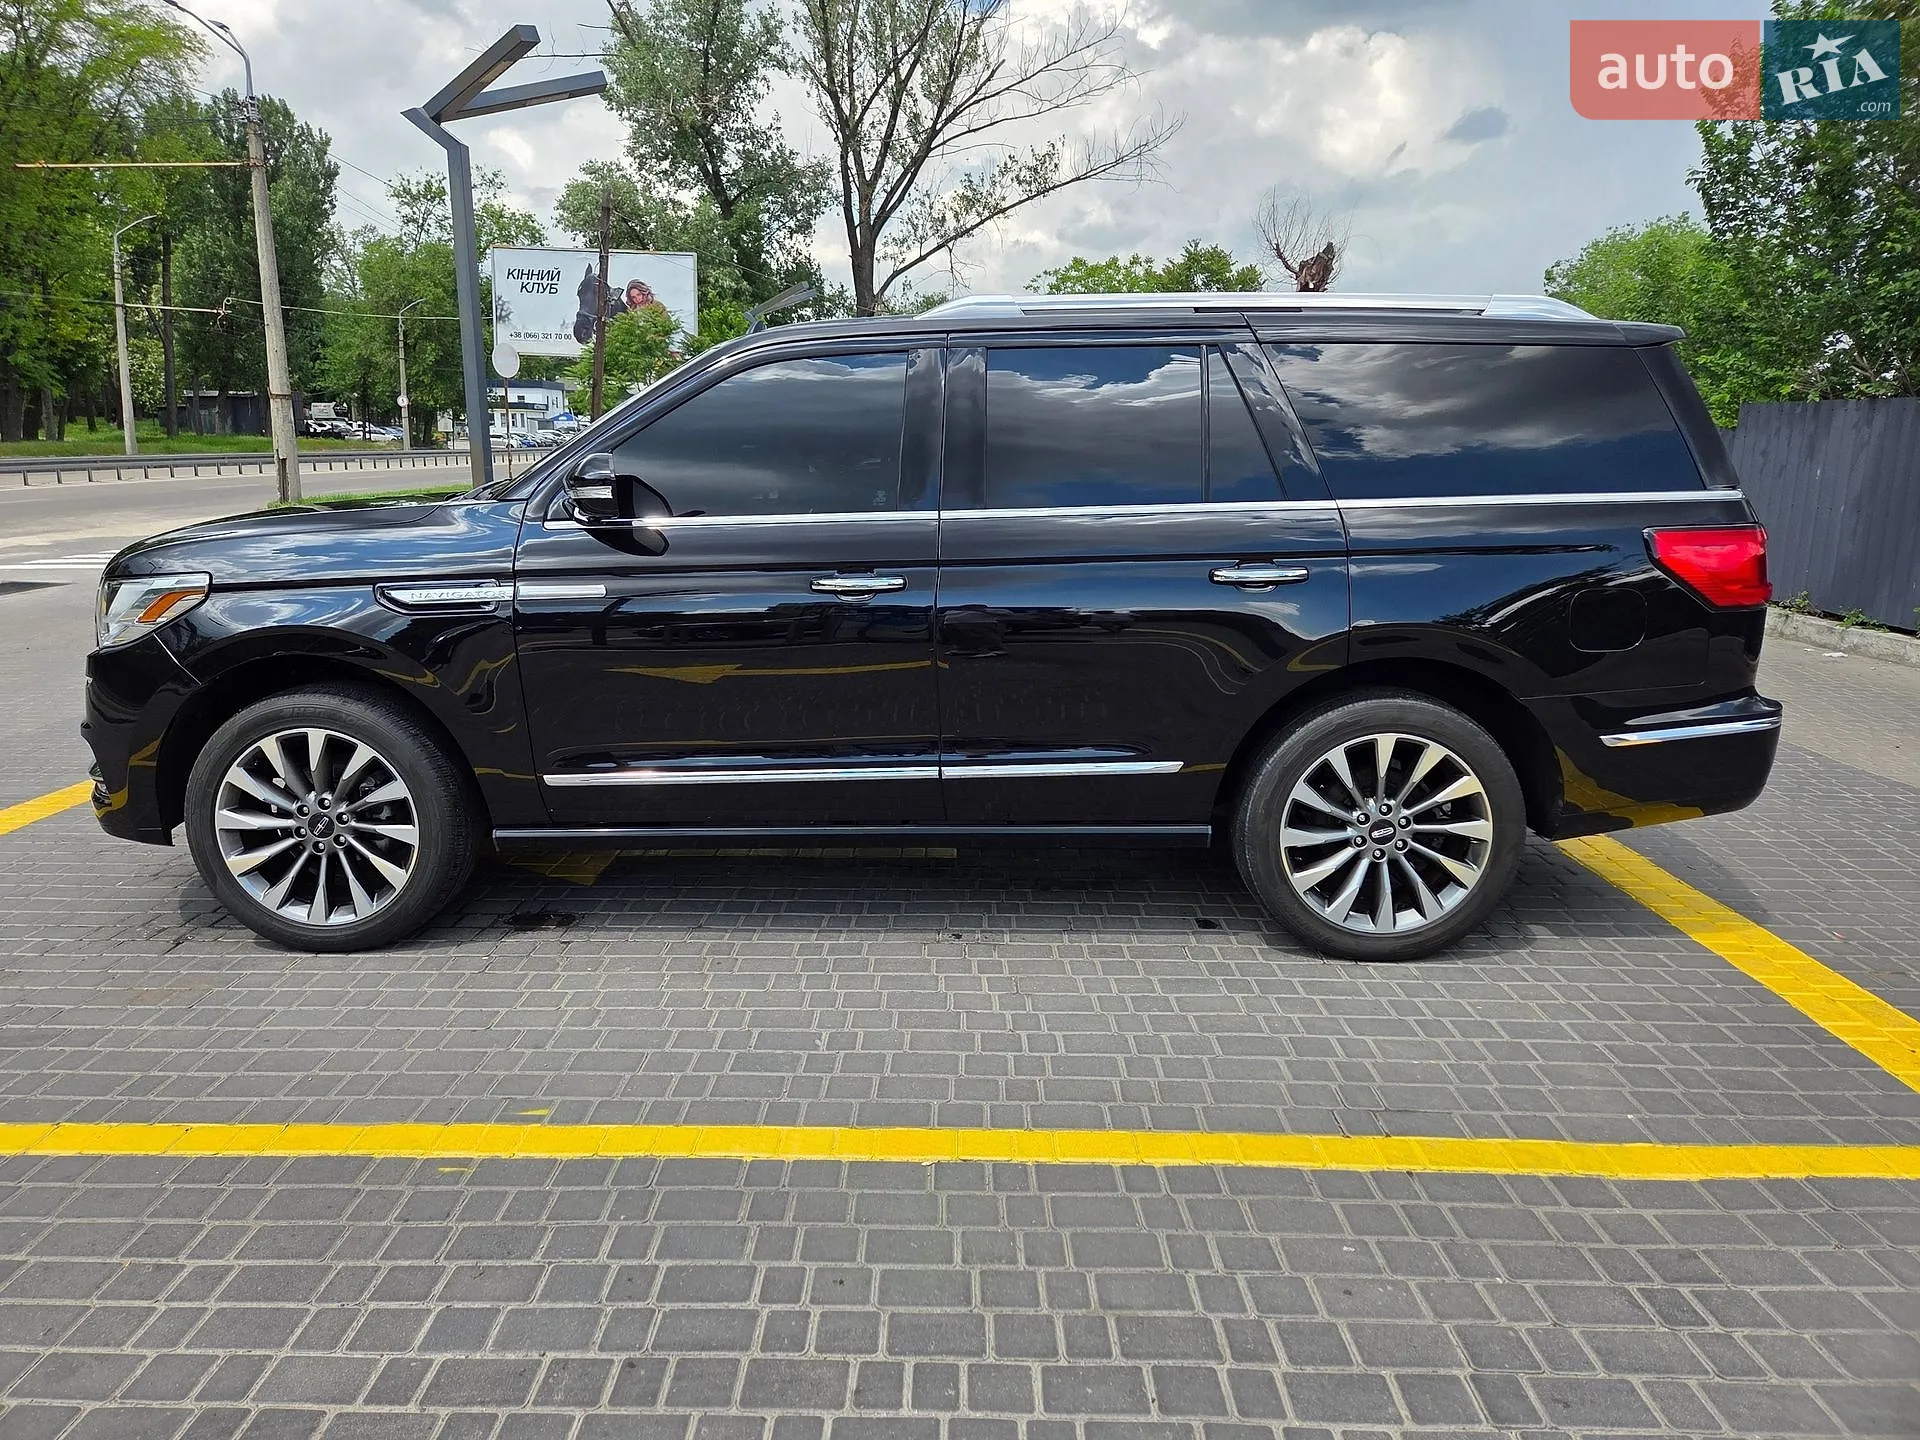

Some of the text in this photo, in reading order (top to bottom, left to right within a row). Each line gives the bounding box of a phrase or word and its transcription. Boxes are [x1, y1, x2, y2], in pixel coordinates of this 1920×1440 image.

[506, 267, 561, 281] КІННИЙ
[520, 281, 559, 295] КЛУБ
[509, 331, 522, 339] +38
[523, 332, 540, 340] (066)
[541, 332, 553, 340] 321
[410, 590, 507, 600] NAVIGATOR
